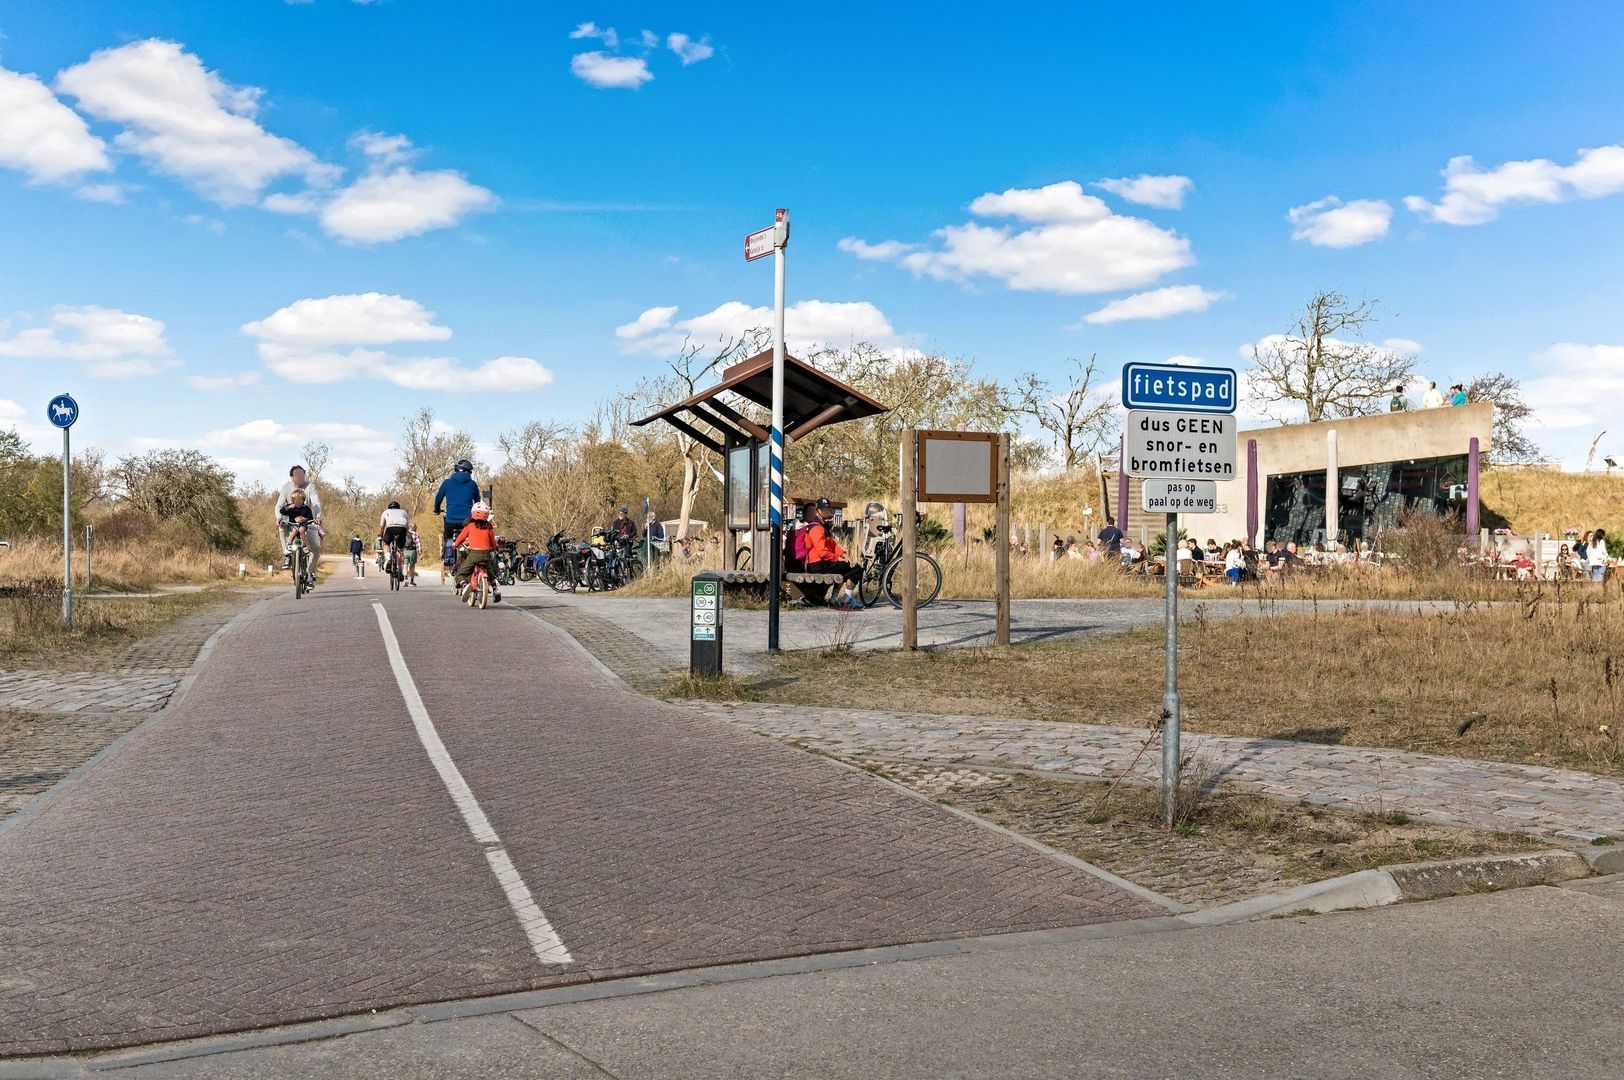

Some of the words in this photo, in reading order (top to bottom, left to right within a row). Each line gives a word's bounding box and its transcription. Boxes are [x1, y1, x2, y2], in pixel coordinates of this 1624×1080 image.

[1134, 374, 1229, 402] fietspad
[1140, 416, 1170, 432] dus
[1176, 418, 1223, 434] GEEN
[1146, 439, 1192, 452] snor-
[1198, 441, 1217, 454] en
[1131, 456, 1232, 474] bromfietsen
[1167, 483, 1182, 493] pas
[1185, 483, 1196, 494] op
[1148, 496, 1167, 509] paal
[1170, 497, 1181, 508] op
[1183, 496, 1194, 507] de
[1196, 497, 1214, 510] weg
